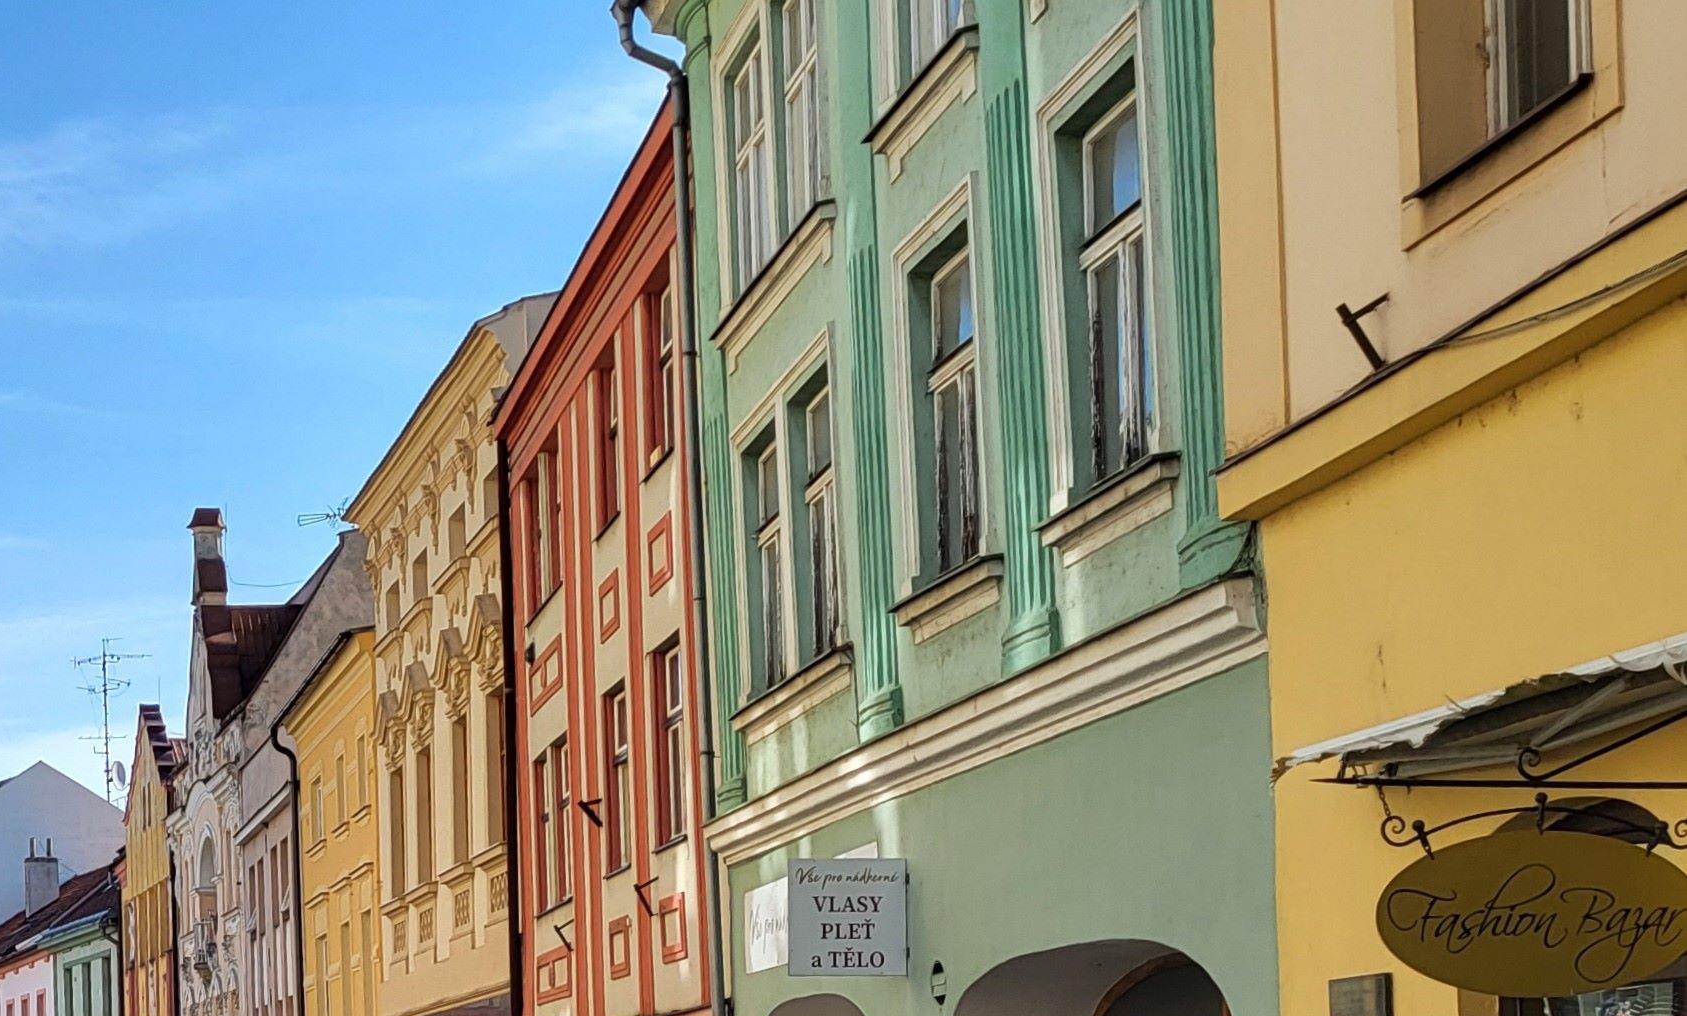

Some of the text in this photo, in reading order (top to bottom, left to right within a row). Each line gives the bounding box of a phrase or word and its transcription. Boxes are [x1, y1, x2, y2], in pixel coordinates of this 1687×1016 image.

[795, 866, 821, 885] Vše
[821, 874, 843, 891] pro
[812, 895, 883, 913] VLASY
[820, 918, 875, 940] PLEŤ
[1387, 863, 1687, 983] Fashion Bazar
[811, 947, 885, 968] a TĚLO
